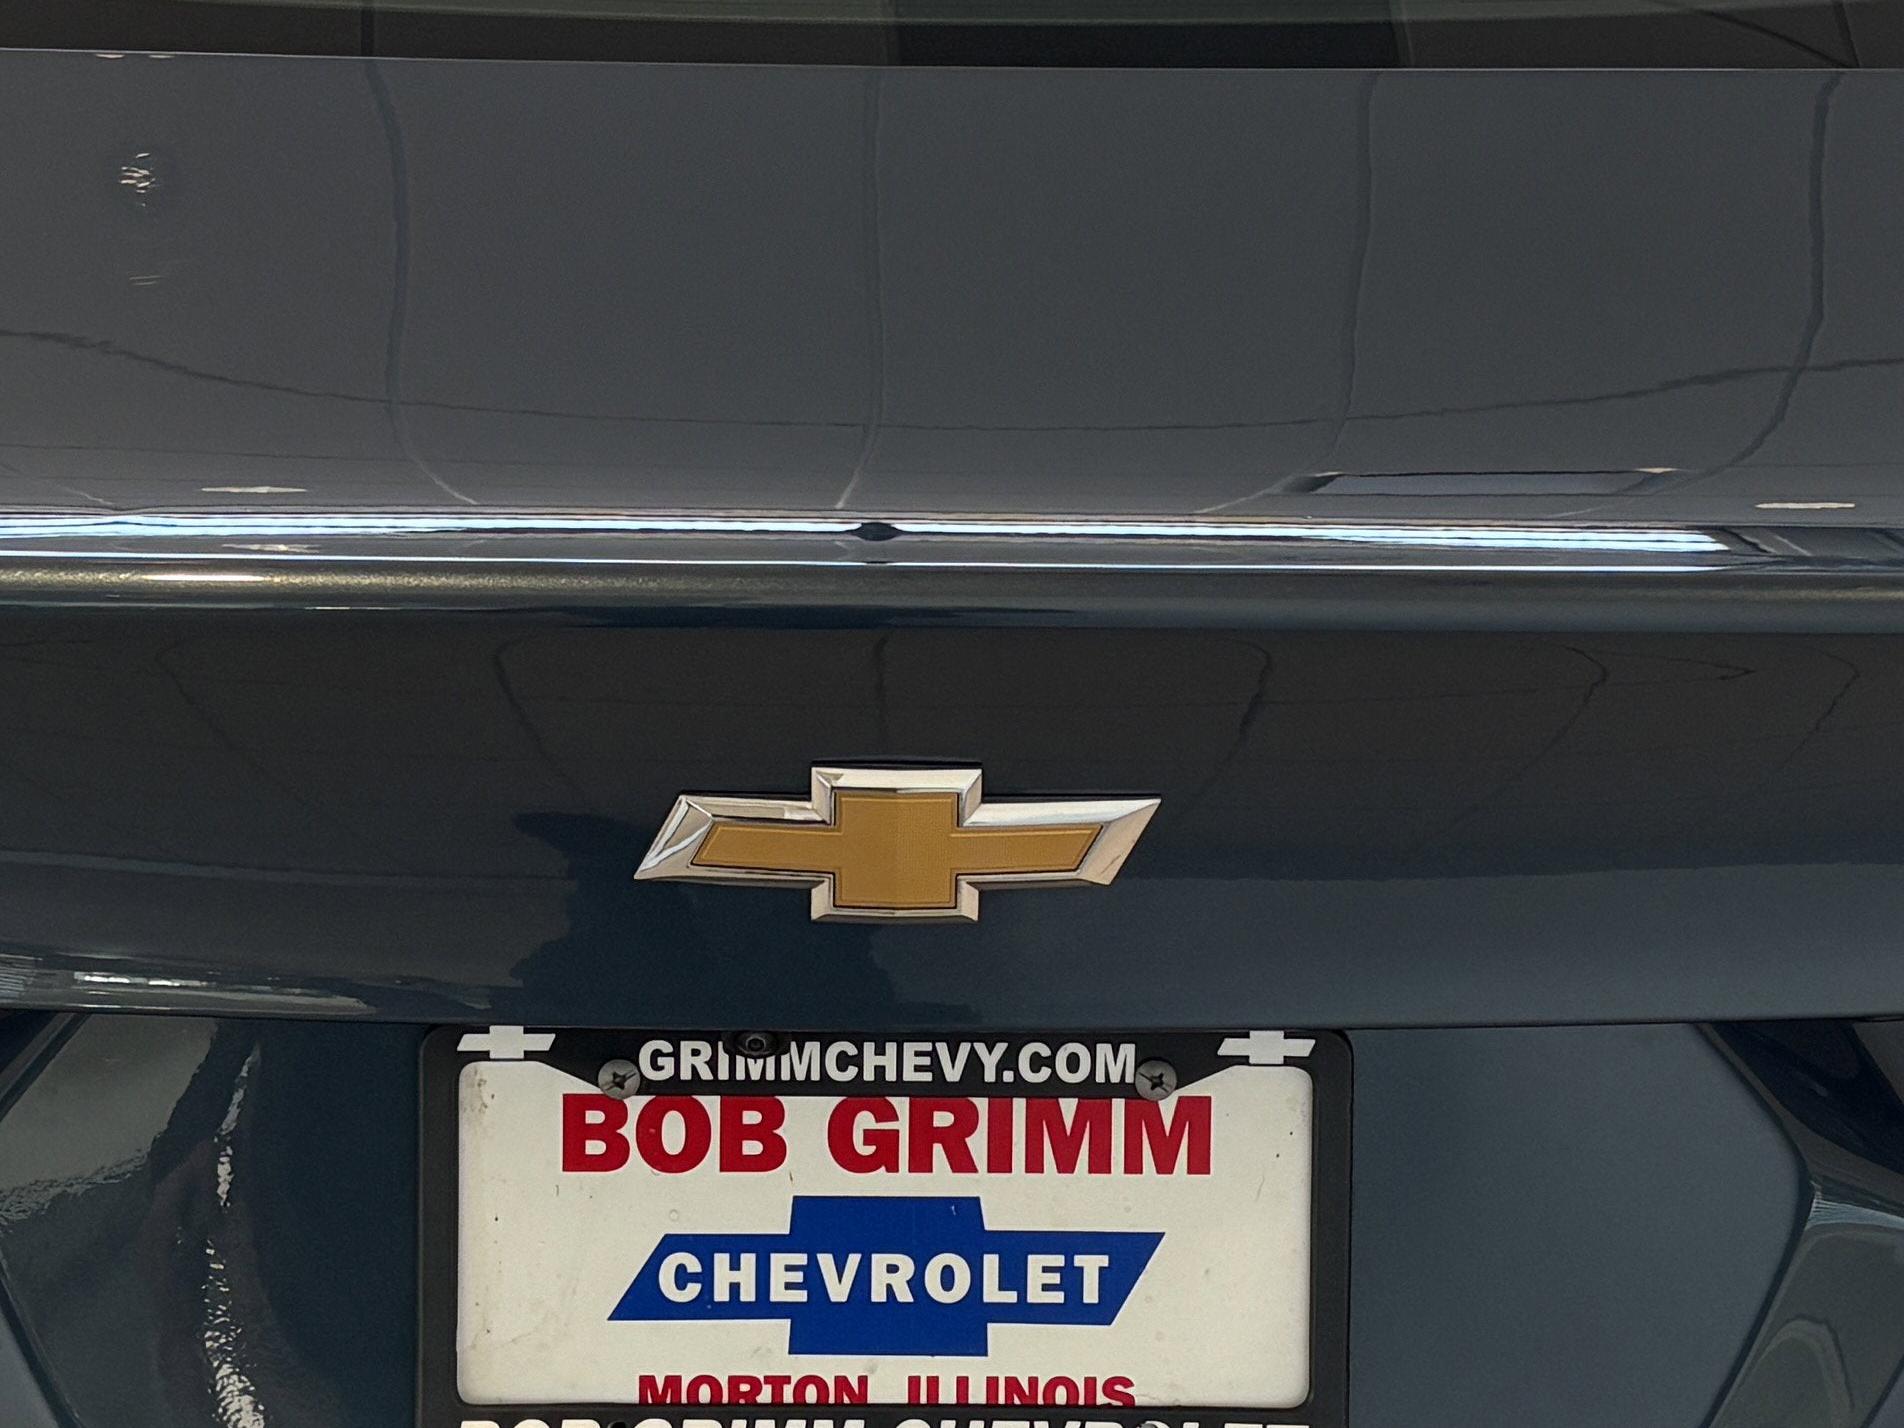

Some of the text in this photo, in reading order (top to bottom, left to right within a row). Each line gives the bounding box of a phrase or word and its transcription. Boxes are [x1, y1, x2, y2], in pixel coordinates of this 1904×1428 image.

[637, 1039, 1136, 1083] GRIMMCHEVY.COM
[562, 1093, 1212, 1176] BOB GRIMM
[657, 1251, 1110, 1305] CHEVROLET
